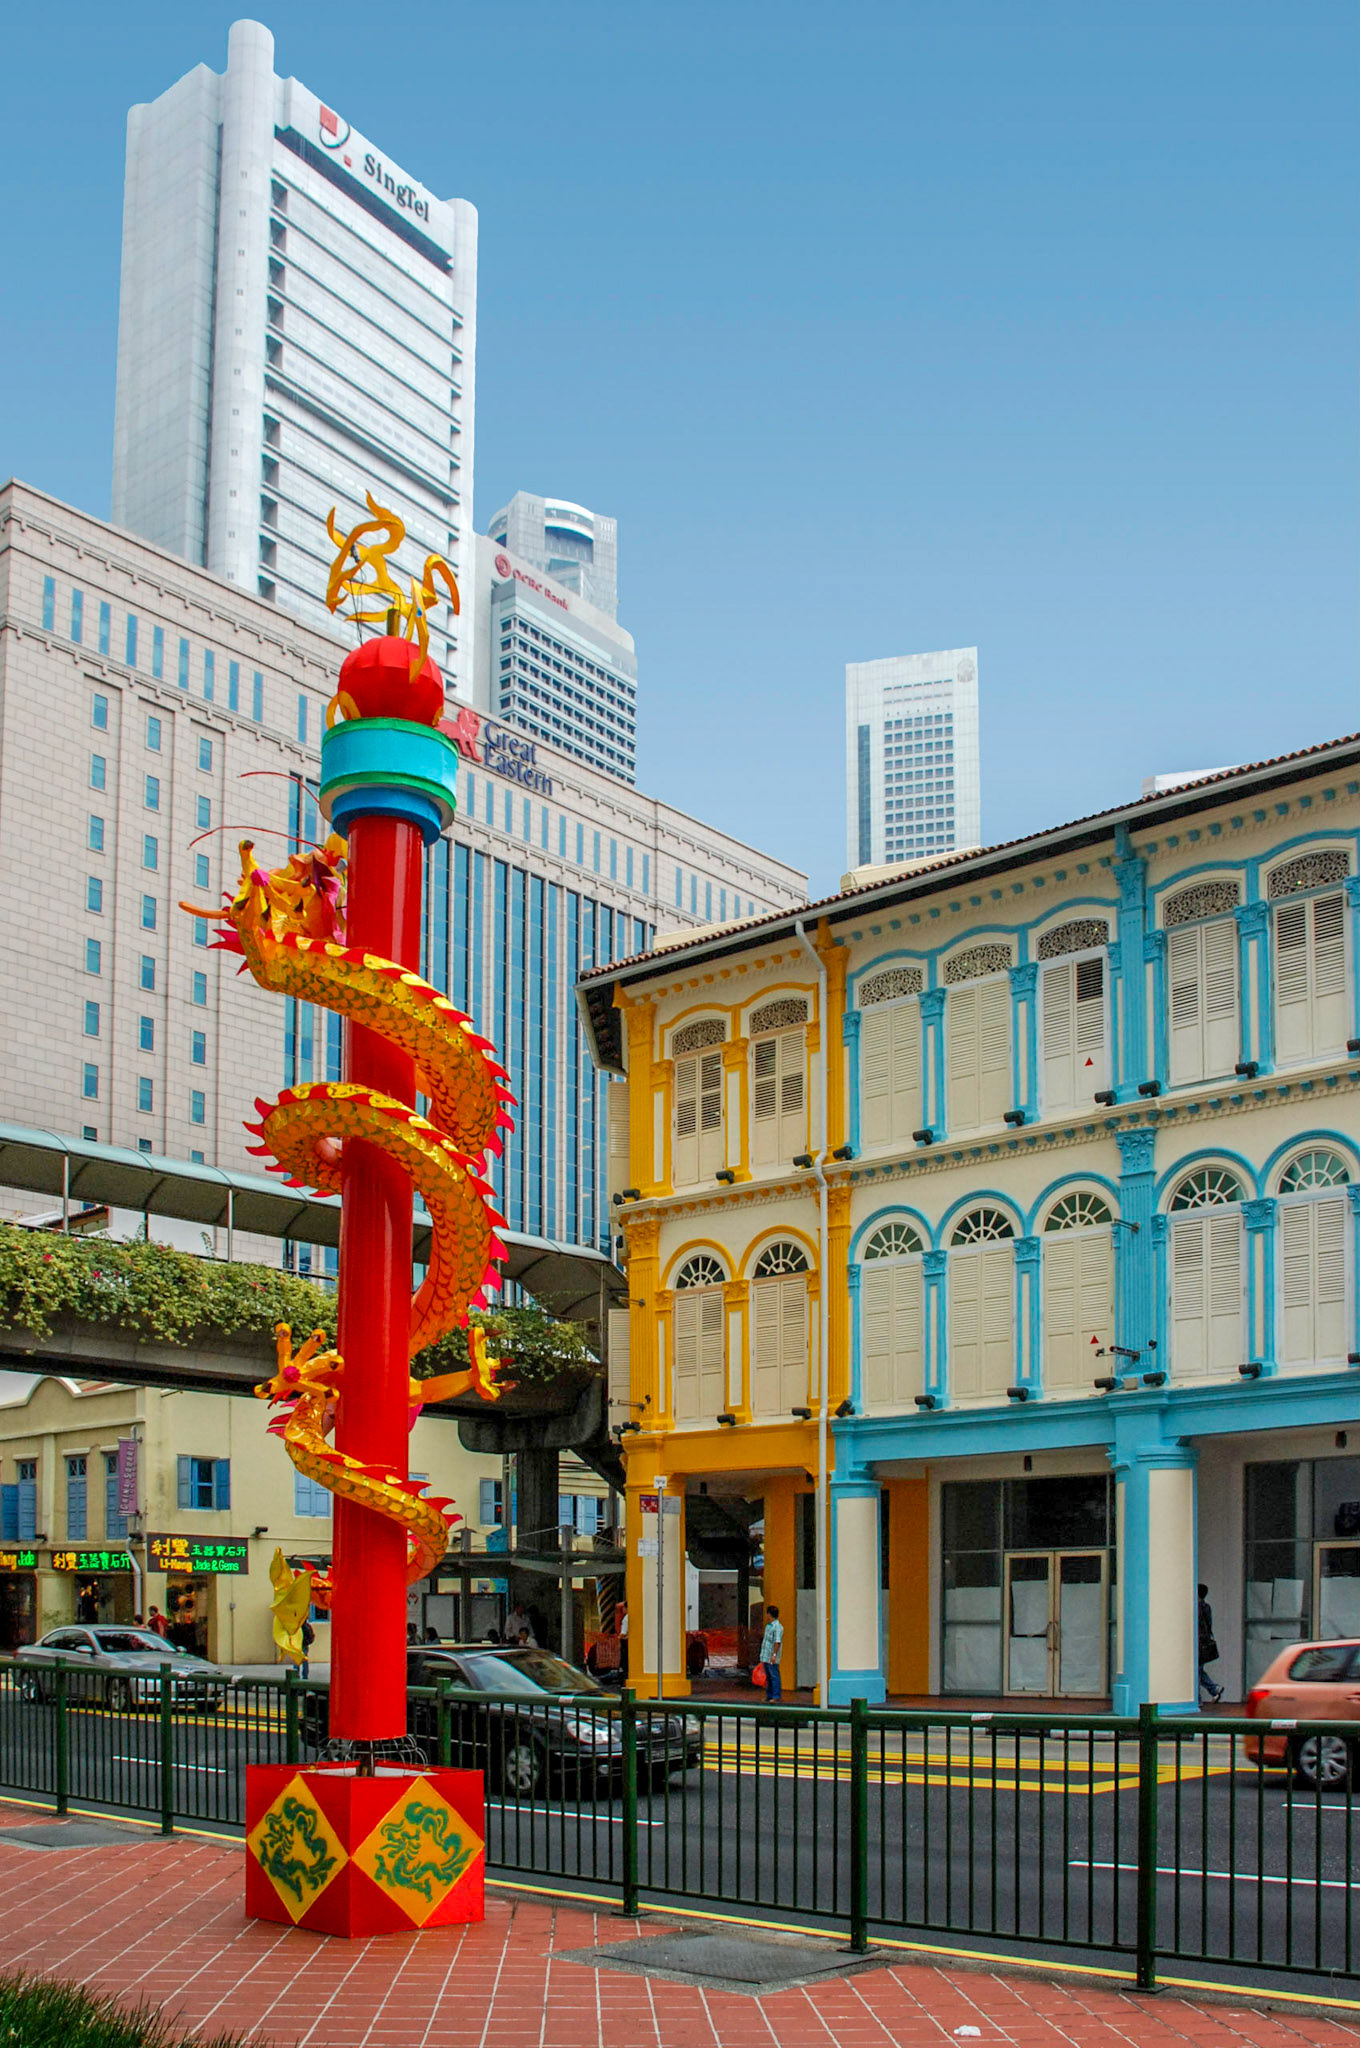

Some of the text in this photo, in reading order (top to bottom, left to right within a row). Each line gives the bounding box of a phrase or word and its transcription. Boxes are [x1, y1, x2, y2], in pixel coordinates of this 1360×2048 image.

[364, 153, 429, 223] SingTel
[544, 588, 569, 611] Bank
[484, 721, 537, 765] Great
[484, 743, 553, 796] Eastern
[18, 1550, 35, 1567] Jade
[193, 1559, 211, 1571] Jade
[211, 1559, 219, 1571] &
[218, 1559, 240, 1571] Gems
